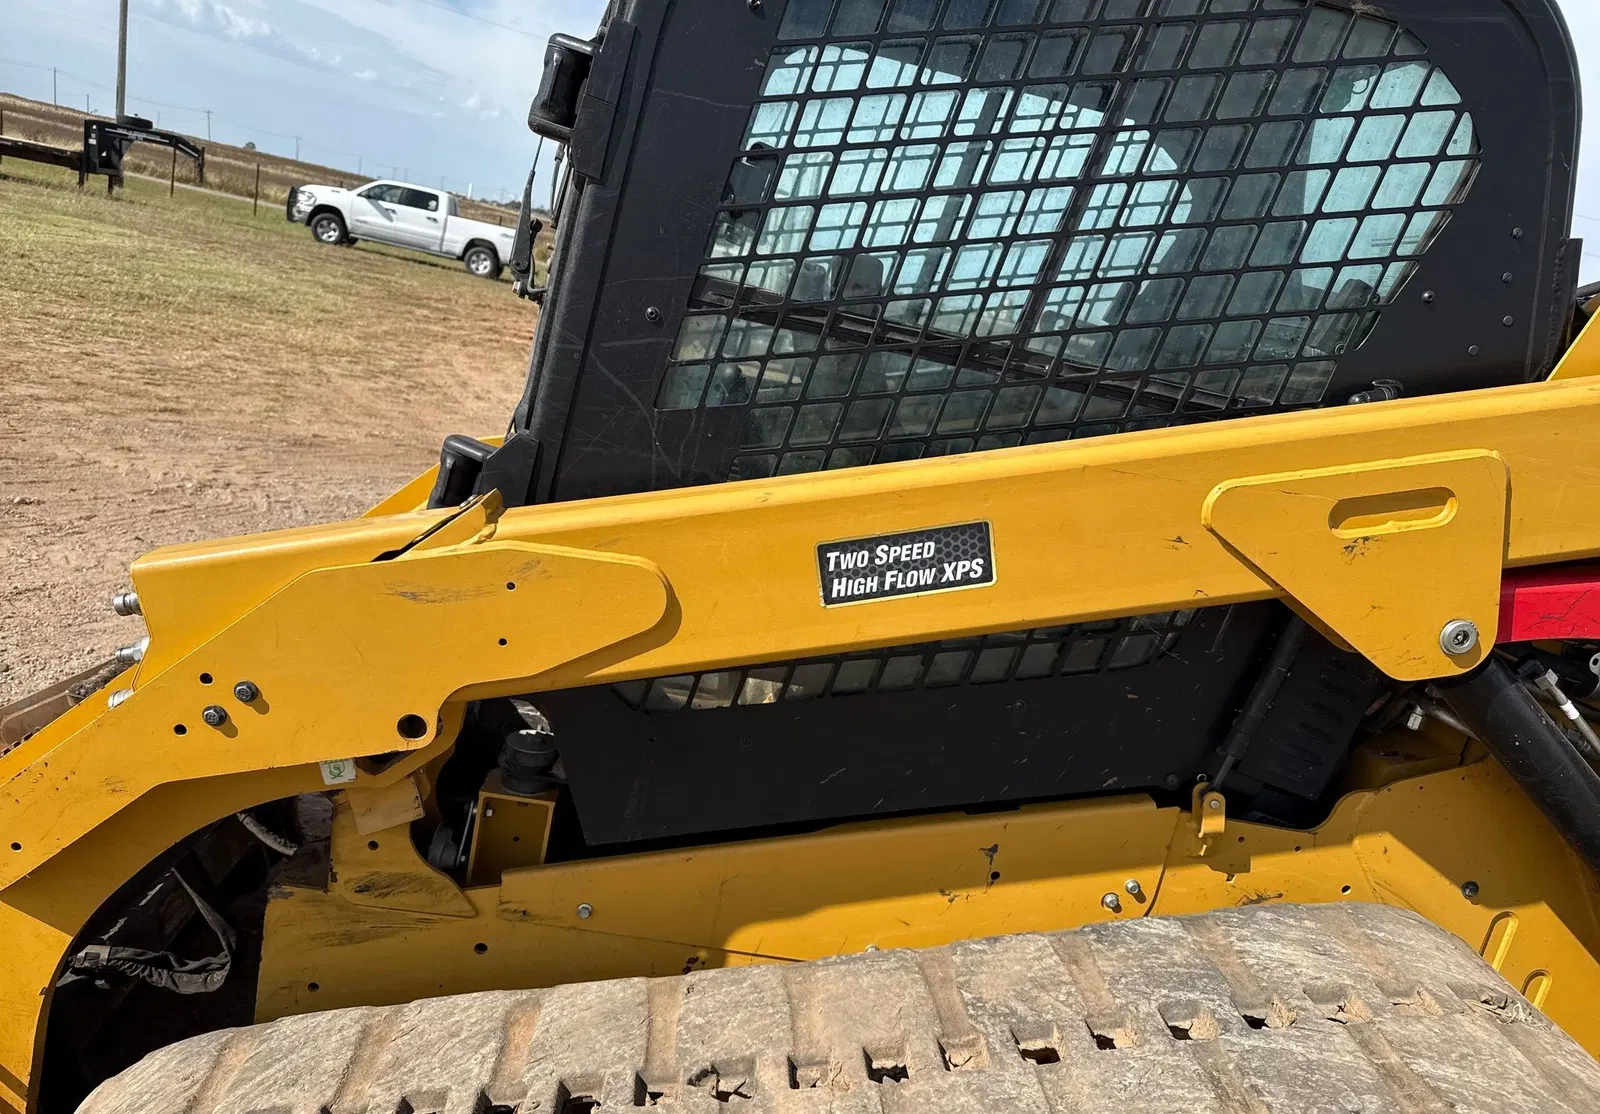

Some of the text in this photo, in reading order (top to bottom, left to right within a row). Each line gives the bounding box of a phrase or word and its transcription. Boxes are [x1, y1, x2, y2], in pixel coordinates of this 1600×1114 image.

[826, 541, 936, 572] TWO SPEED
[831, 558, 984, 598] HIGH FLOW XPS
